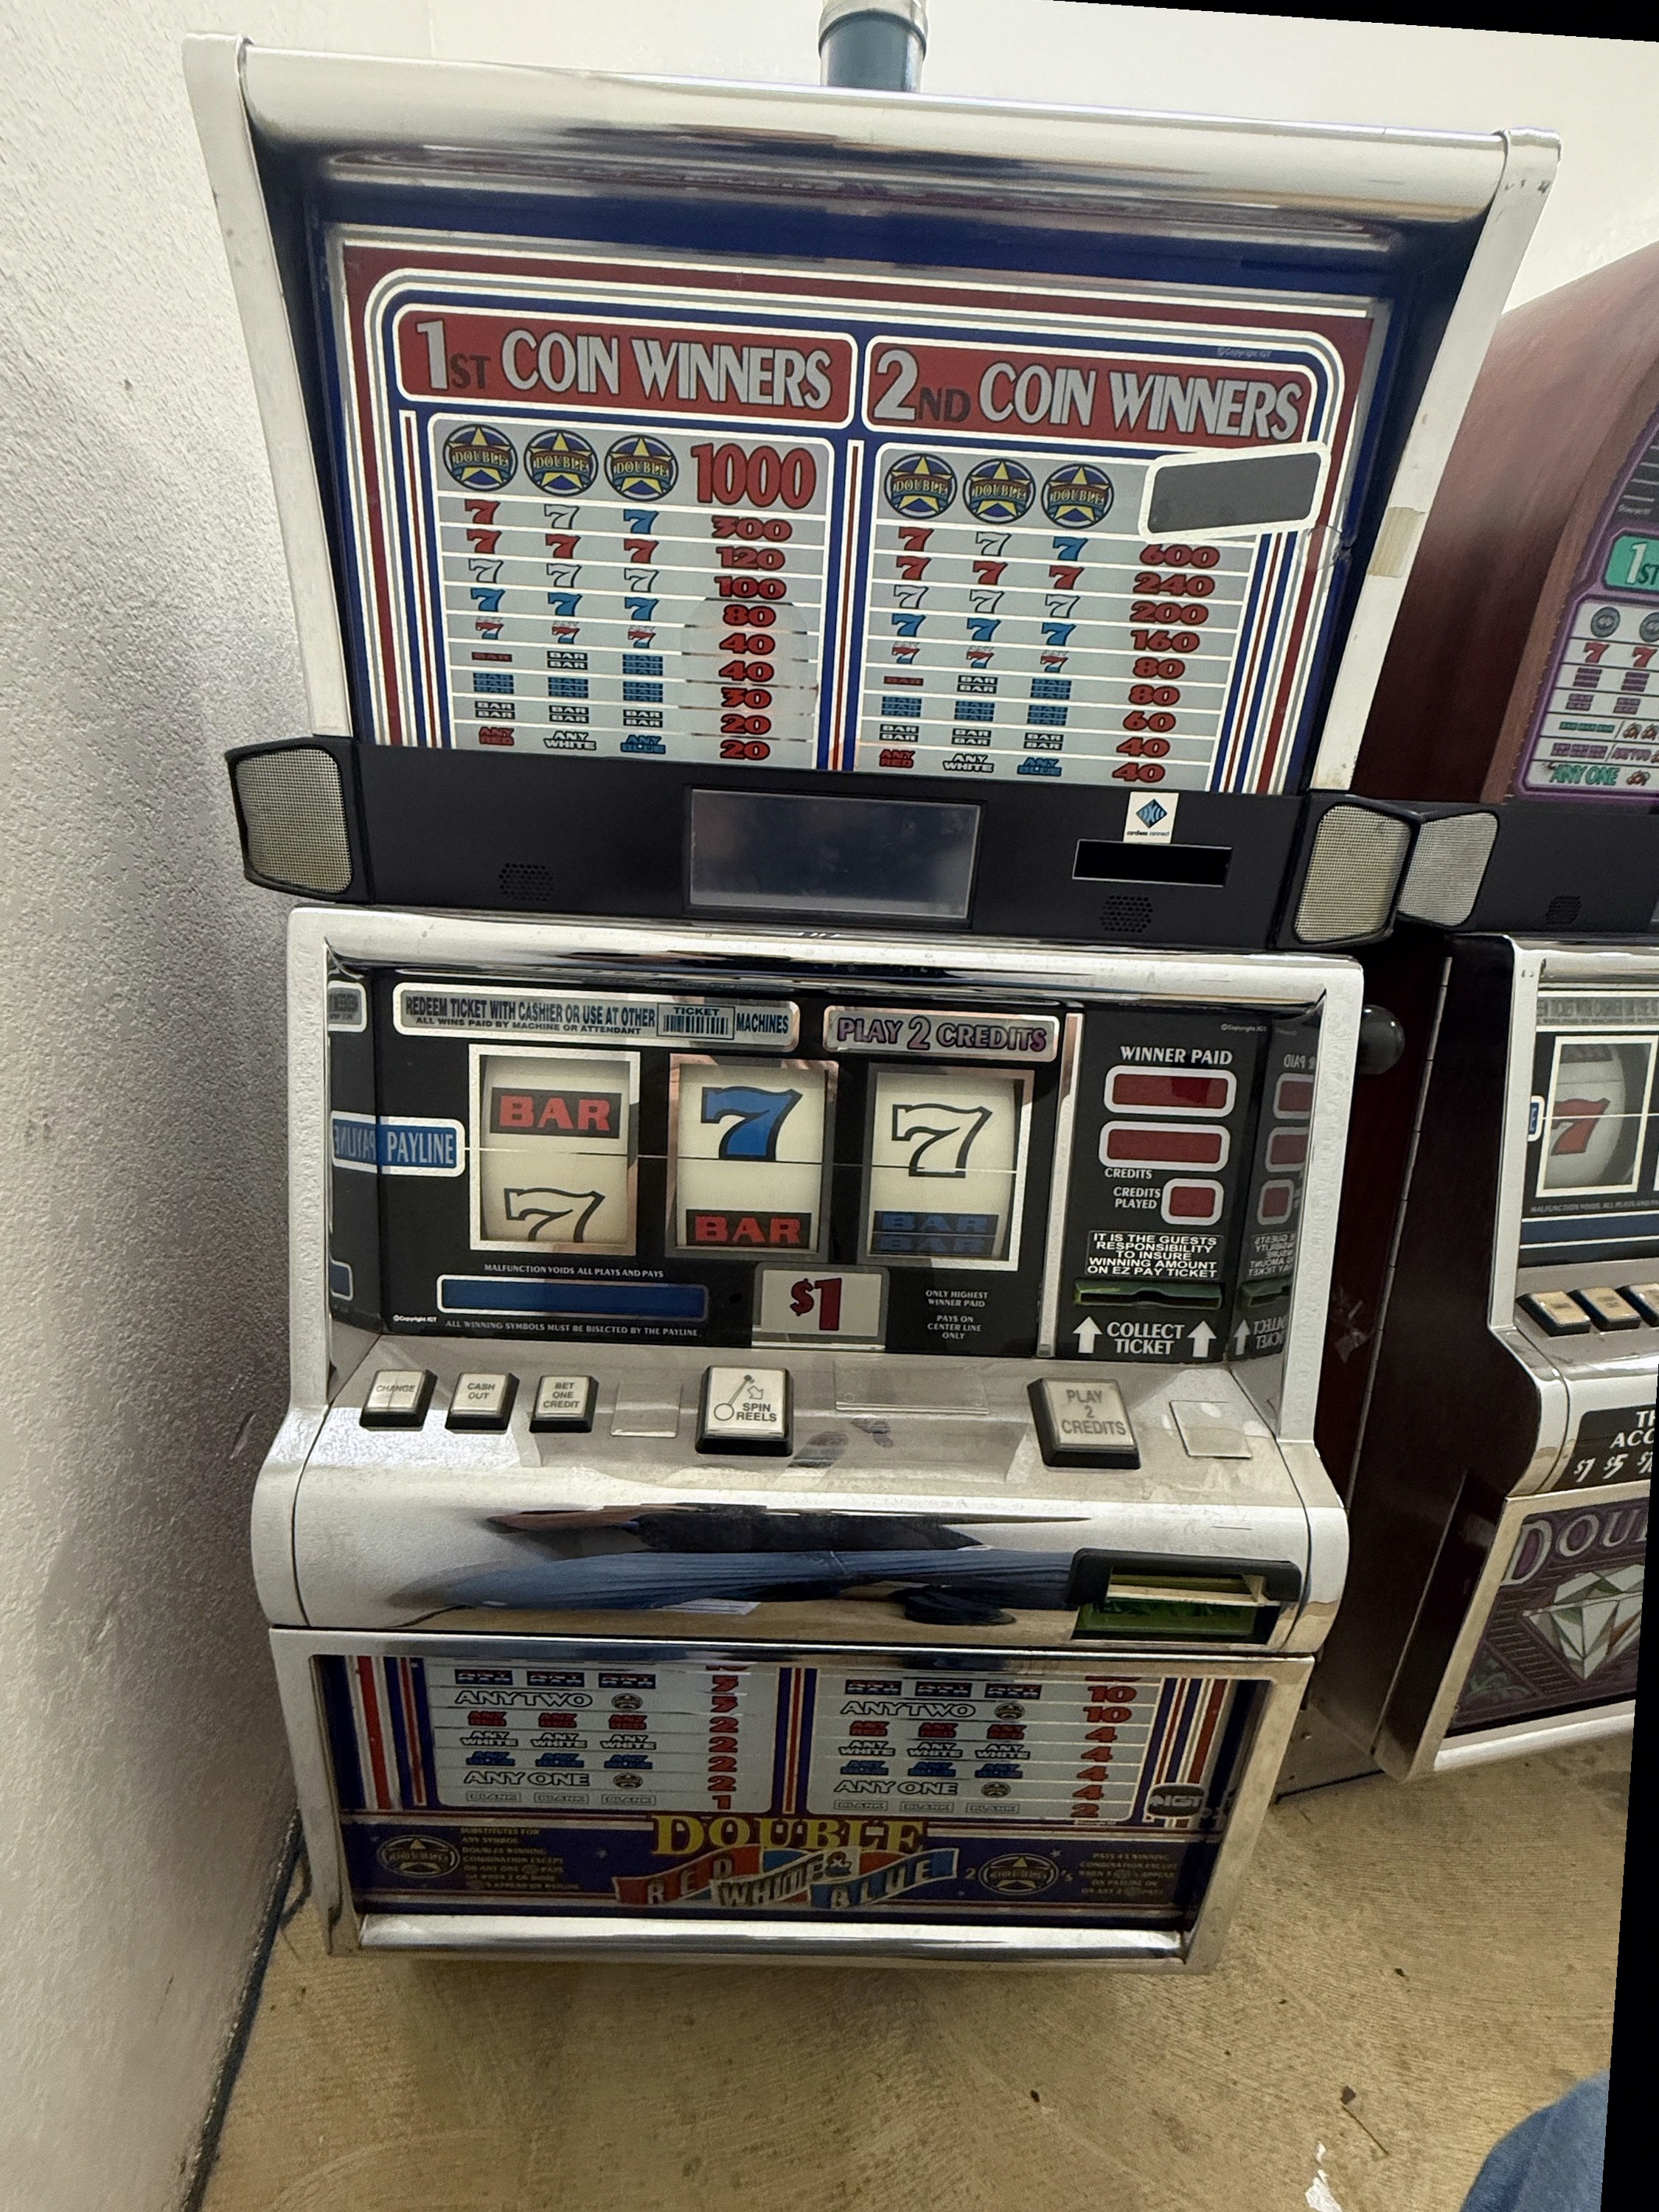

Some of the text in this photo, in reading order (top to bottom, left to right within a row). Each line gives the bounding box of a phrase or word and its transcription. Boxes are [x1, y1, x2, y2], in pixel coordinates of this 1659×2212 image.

[416, 320, 832, 410] 1ST COIN WINNERS
[874, 348, 1303, 440] 2ND COIN WINNERS
[455, 450, 506, 465] DOUBLE
[536, 455, 587, 471] DOUBLE
[616, 461, 667, 477] DOUBLE
[691, 442, 817, 510] 1000
[896, 479, 946, 495] DOUBLE
[974, 484, 1023, 501] DOUBLE
[1053, 490, 1102, 506] DOUBLE
[712, 515, 793, 543] 300
[716, 546, 785, 571] 120
[1139, 543, 1220, 568] 600
[714, 576, 787, 599] 100
[1133, 571, 1216, 597] 240
[723, 604, 776, 628] 80
[1130, 601, 1208, 626] 200
[719, 633, 776, 655] 40
[1130, 629, 1200, 654] 160
[1583, 641, 1610, 664] 7
[1632, 647, 1658, 668] 7
[719, 661, 774, 683] 40
[1133, 656, 1186, 680] 80
[720, 687, 772, 709] 30
[1128, 684, 1180, 707] 80
[720, 714, 771, 735] 20
[1123, 712, 1176, 734] 60
[544, 737, 596, 751] WHITE
[552, 731, 588, 742] ANY
[720, 740, 771, 761] 20
[1116, 737, 1169, 758] 40
[943, 760, 994, 774] WHITE
[953, 753, 989, 764] ANY
[1112, 763, 1166, 783] 40
[1585, 766, 1621, 786] ONE
[406, 996, 655, 1027] REDEEM TICKET WITH CASHIER OR USE AT OTHER
[673, 1006, 720, 1017] TICKET
[438, 1018, 465, 1026] WINS
[468, 1019, 492, 1027] PAID
[495, 1020, 509, 1029] BY
[512, 1021, 560, 1031] MACHINE
[563, 1023, 577, 1032] OR
[580, 1025, 642, 1034] ATTENDANT
[737, 1012, 789, 1034] MACHINES
[836, 1016, 1047, 1052] PLAY 2 CREDITS
[1120, 1046, 1233, 1065] WINNER PAID
[499, 1094, 611, 1131] BAR
[700, 1085, 804, 1163] 7
[1551, 1097, 1611, 1156] 7
[386, 1131, 454, 1164] PAYLINE
[891, 1104, 994, 1179] 7
[1105, 1168, 1152, 1180] CREDITS
[1113, 1186, 1161, 1200] CREDITS
[1114, 1197, 1158, 1210] PLAYED
[504, 1187, 605, 1242] 7
[695, 1214, 801, 1244] BAR
[1093, 1233, 1217, 1245] IT IS THE GUESTS
[1096, 1242, 1214, 1253] RESPONSIBILITY
[1089, 1257, 1217, 1270] WINNING AMOUNT
[1116, 1250, 1192, 1261] TO INSURE
[484, 1263, 664, 1279] MALFUNCTION VOIDS ALL PLAYS AND PAYS
[1087, 1265, 1217, 1278] ON EZ PAY TICKET
[925, 1290, 988, 1299] ONLY HIGHEST
[928, 1298, 961, 1307] WINNER
[789, 1277, 842, 1331] $1
[445, 1319, 461, 1327] ALL
[463, 1320, 503, 1329] WINNING
[504, 1322, 545, 1331] SYMBOLS
[547, 1324, 570, 1332] MUST
[572, 1324, 583, 1332] BE
[586, 1325, 627, 1334] BISECTED
[644, 1327, 660, 1335] THE
[927, 1323, 961, 1331] CENTER
[1107, 1321, 1185, 1340] COLLECT
[1114, 1338, 1175, 1354] TICKET
[376, 1382, 415, 1394] CHANGE
[467, 1382, 495, 1391] CASH
[554, 1382, 574, 1390] BET
[467, 1391, 490, 1400] OUT
[552, 1391, 574, 1399] ONE
[1066, 1388, 1103, 1404] PLAY
[543, 1400, 580, 1409] CREDIT
[742, 1402, 771, 1413] SPIN
[1084, 1405, 1094, 1418] 2
[736, 1411, 777, 1422] REELS
[1061, 1420, 1127, 1436] CREDITS
[1573, 1457, 1596, 1483] $1
[1602, 1453, 1629, 1479] $5
[1087, 1685, 1138, 1703] 10
[1082, 1706, 1133, 1724] 10
[1085, 1726, 1118, 1743] 4
[1080, 1745, 1113, 1762] 4
[464, 1771, 590, 1787] ANY ONE
[1076, 1764, 1108, 1781] 4
[834, 1780, 958, 1795] ANY ONE
[1072, 1784, 1105, 1800] 4
[1071, 1804, 1099, 1818] 2
[650, 1814, 926, 1856] DOUBLE
[647, 1857, 734, 1905] RED
[830, 1857, 934, 1909] BLUE
